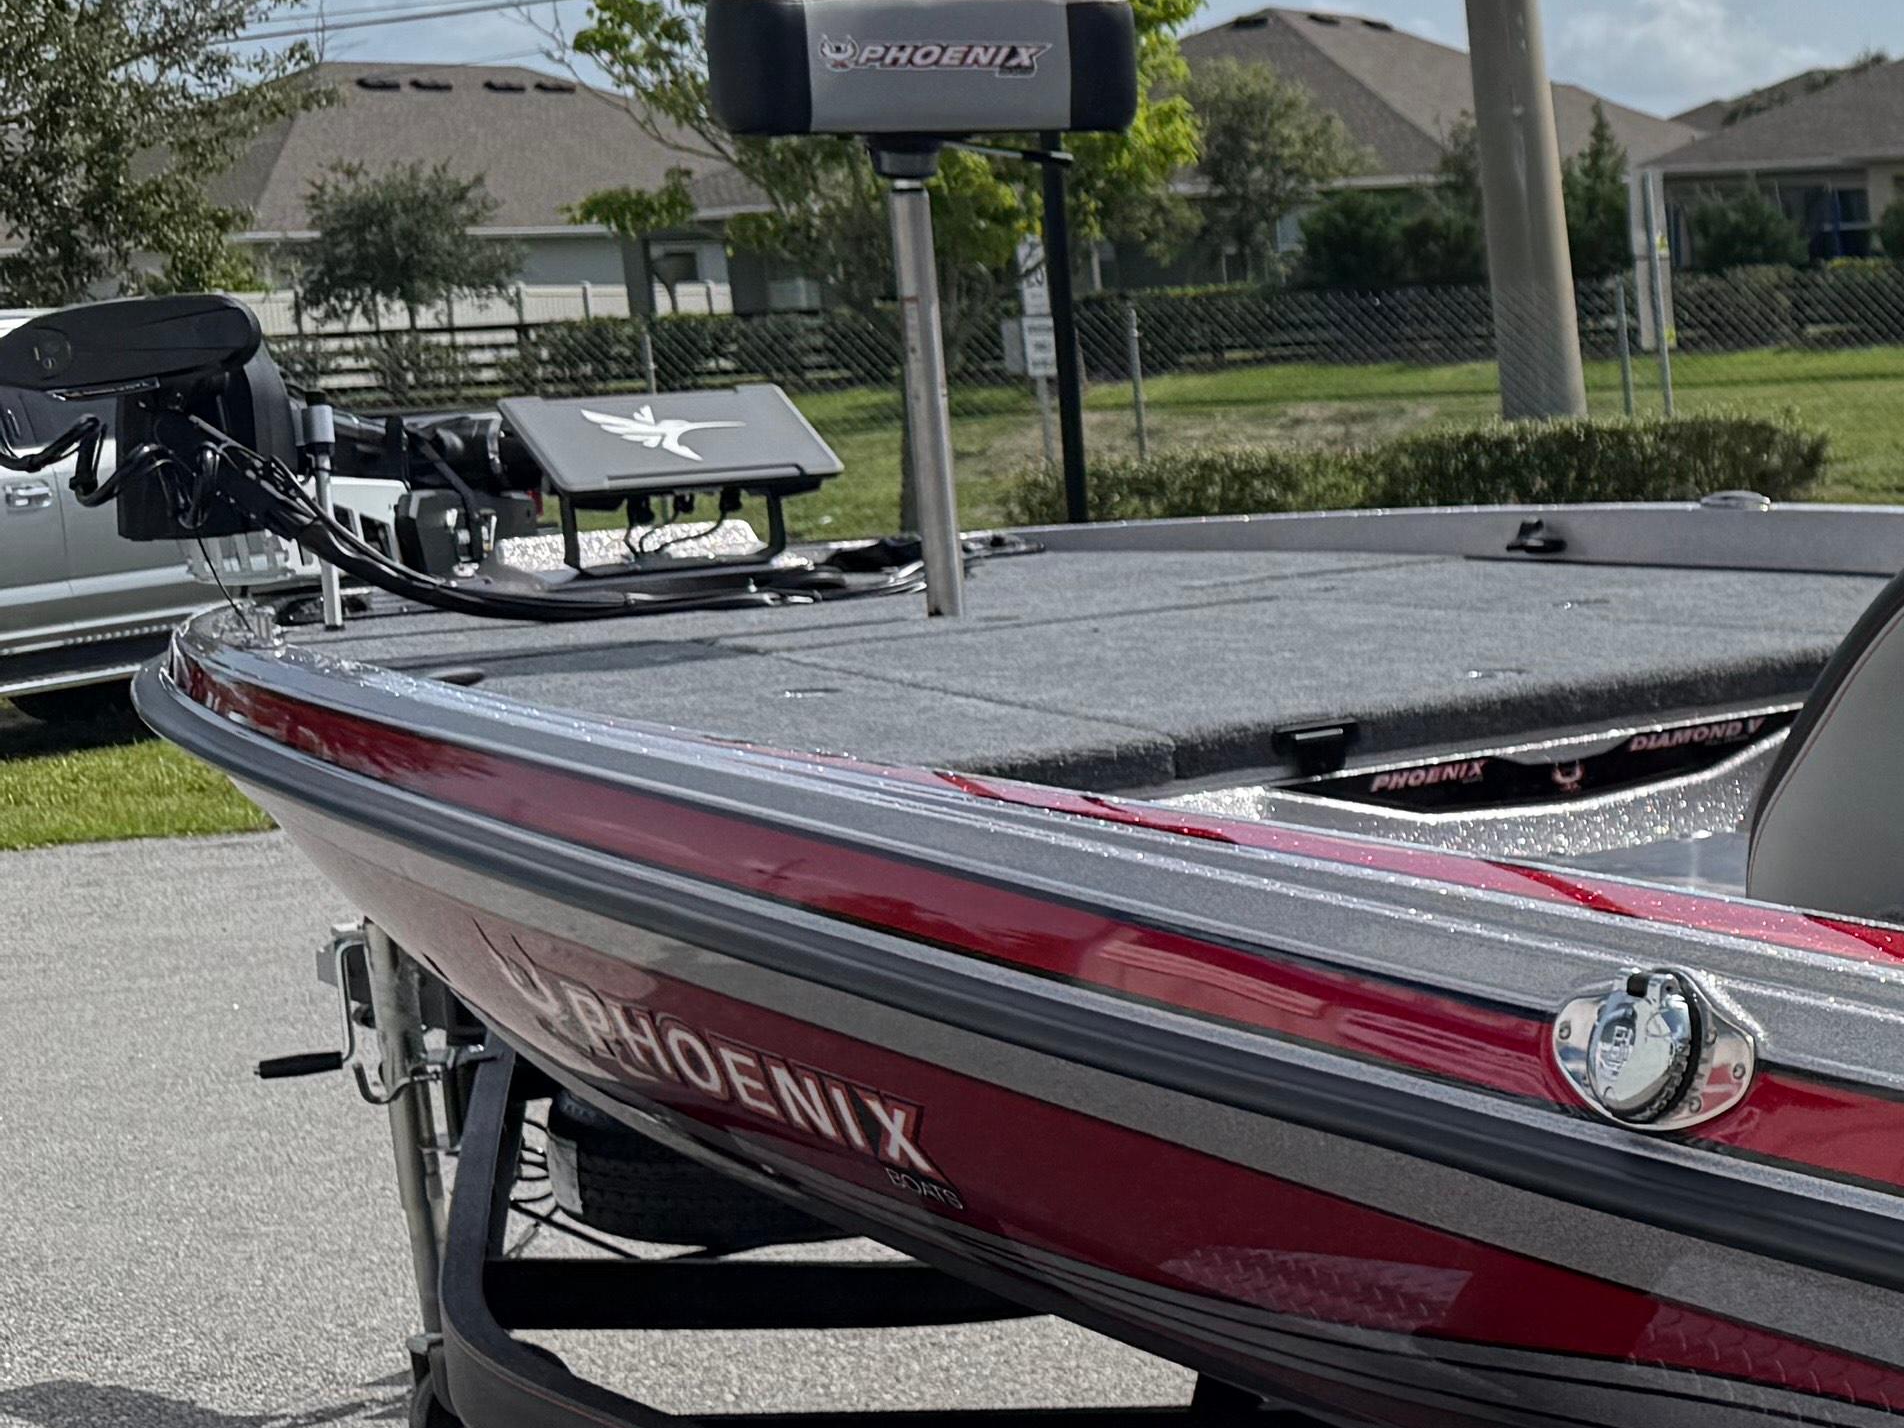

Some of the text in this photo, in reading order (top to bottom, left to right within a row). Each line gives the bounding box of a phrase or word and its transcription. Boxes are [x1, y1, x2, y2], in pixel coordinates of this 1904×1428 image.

[857, 43, 1038, 69] PHOENIX
[1628, 721, 1743, 753] DIAMOND
[1369, 758, 1489, 793] PHOENIX
[560, 979, 936, 1174] PHOENIX
[883, 1165, 964, 1211] BOATS
